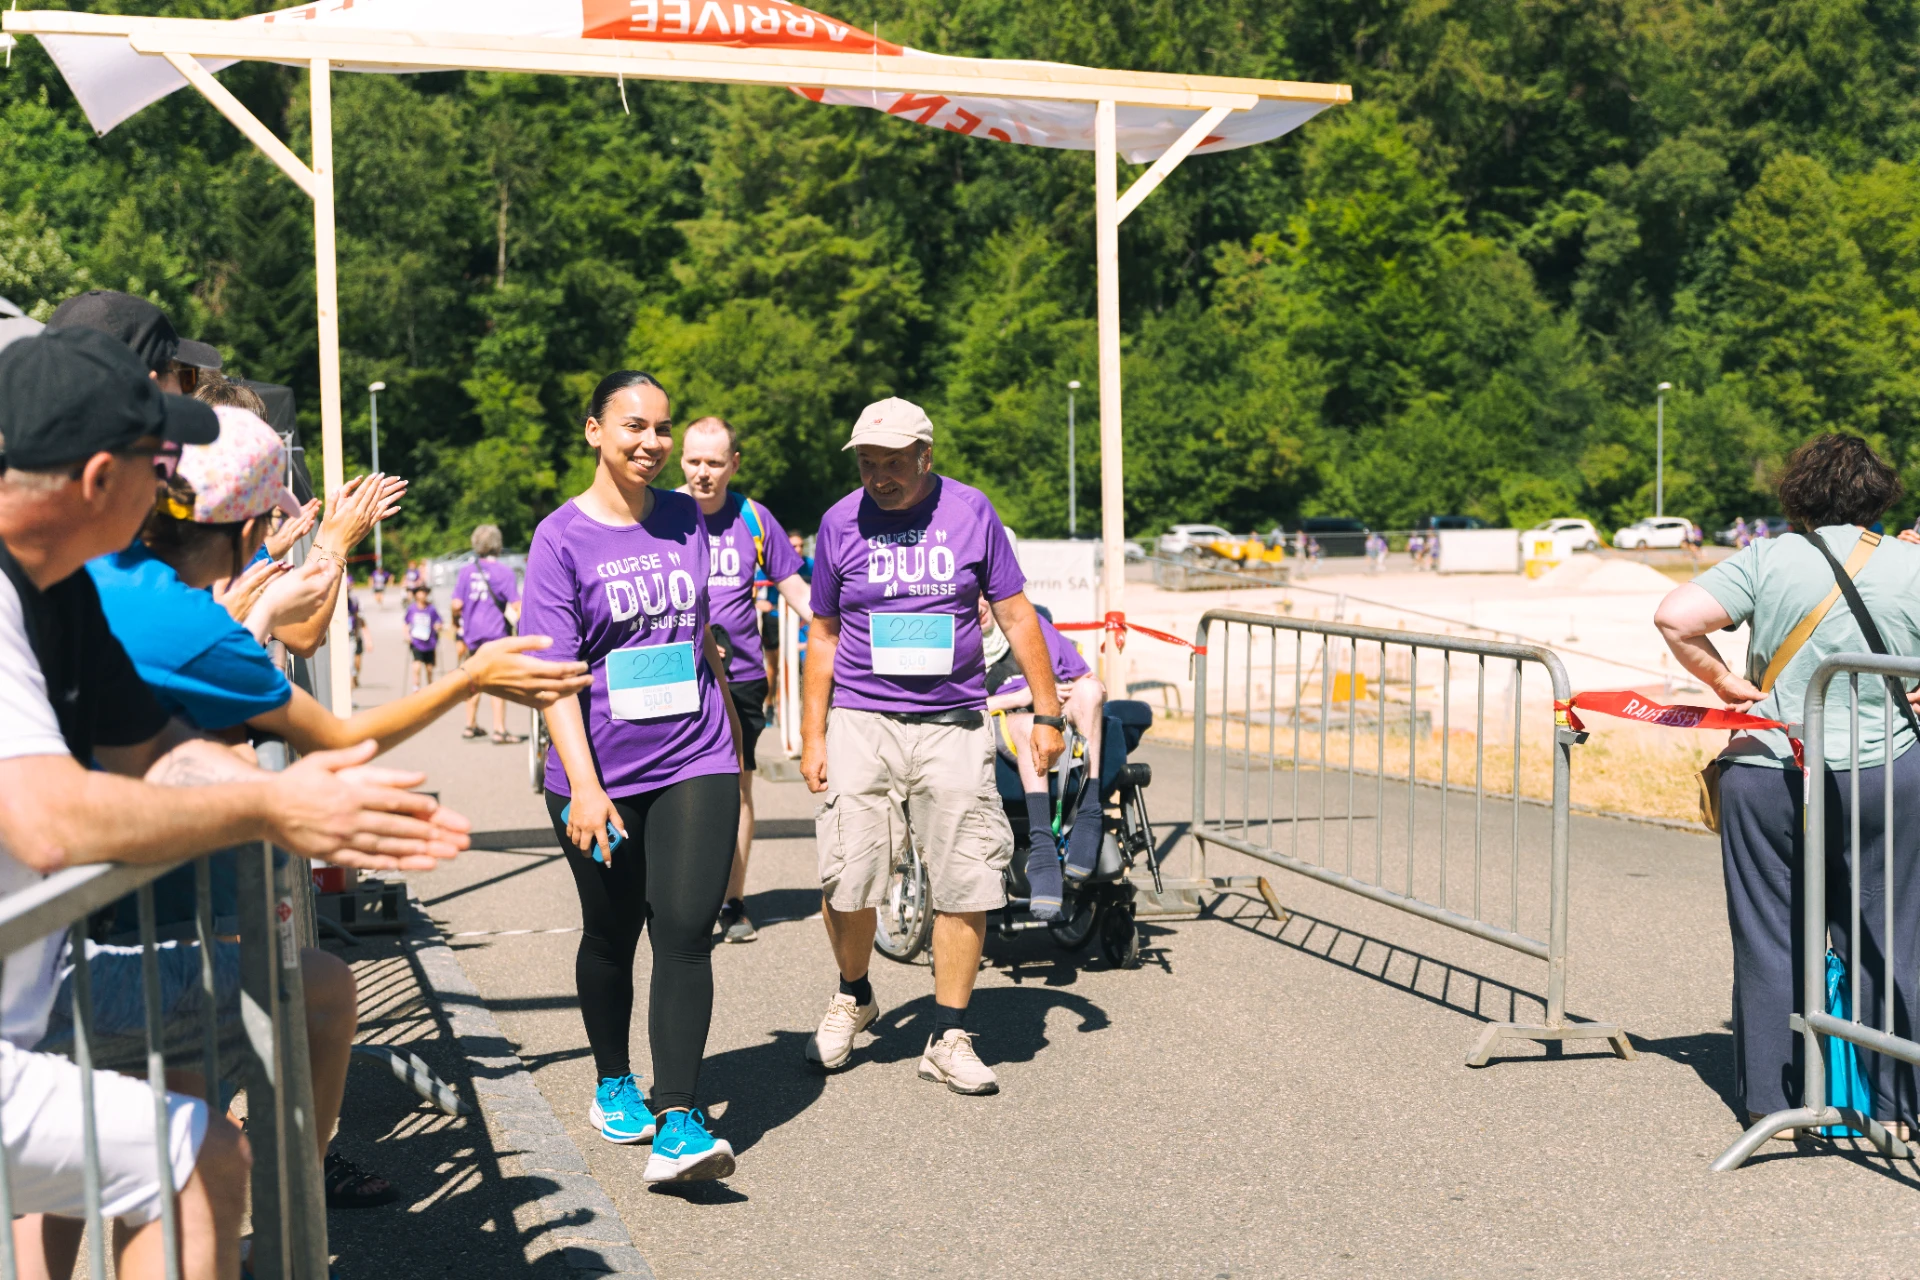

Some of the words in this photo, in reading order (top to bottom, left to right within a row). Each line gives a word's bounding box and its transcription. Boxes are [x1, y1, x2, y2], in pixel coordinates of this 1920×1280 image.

[629, 0, 849, 42] ARRIVEE
[867, 529, 928, 550] COURSE
[596, 552, 663, 578] COURSE
[868, 545, 956, 583] DUO
[908, 583, 957, 596] SUISSE
[1025, 576, 1062, 590] errin
[1068, 576, 1089, 590] SA
[605, 569, 696, 623] DUO
[650, 613, 696, 631] SUISSE
[889, 617, 939, 642] 226
[632, 651, 684, 680] 229
[643, 691, 673, 708] DUO
[1621, 698, 1704, 728] RAIFFEISEN
